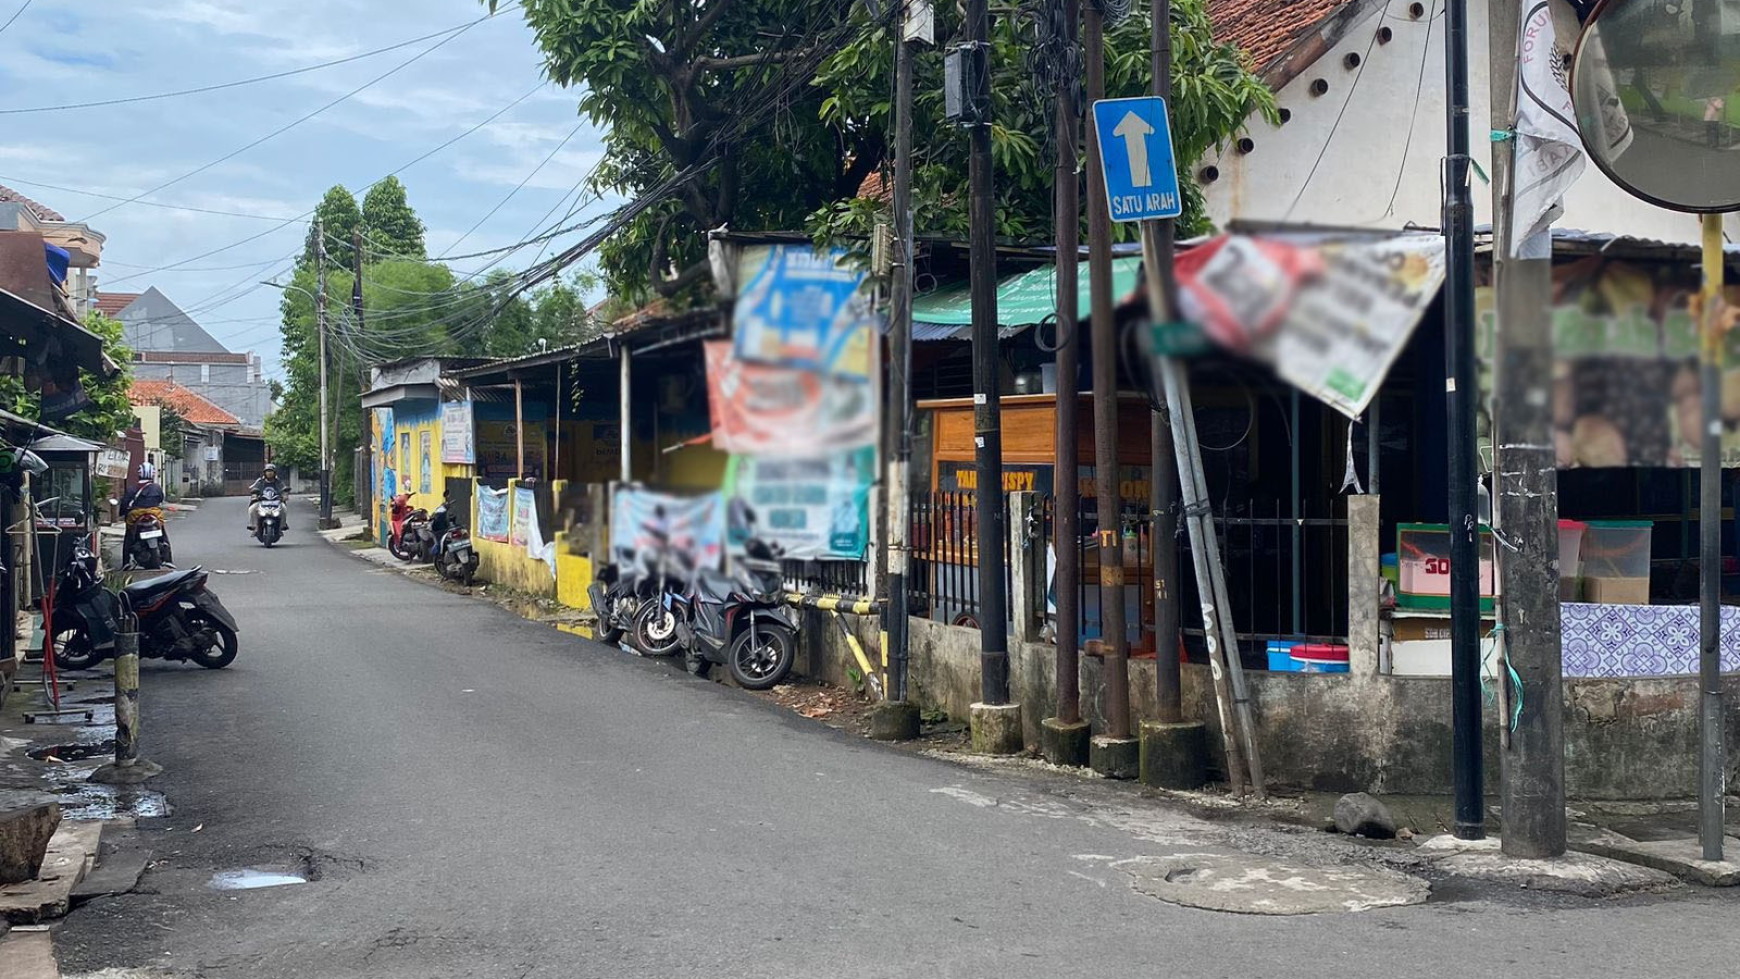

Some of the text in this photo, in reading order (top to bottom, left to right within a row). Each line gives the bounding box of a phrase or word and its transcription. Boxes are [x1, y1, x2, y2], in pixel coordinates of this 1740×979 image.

[1112, 191, 1176, 215] SATU ARAH
[956, 470, 1034, 491] TAH ISPY
